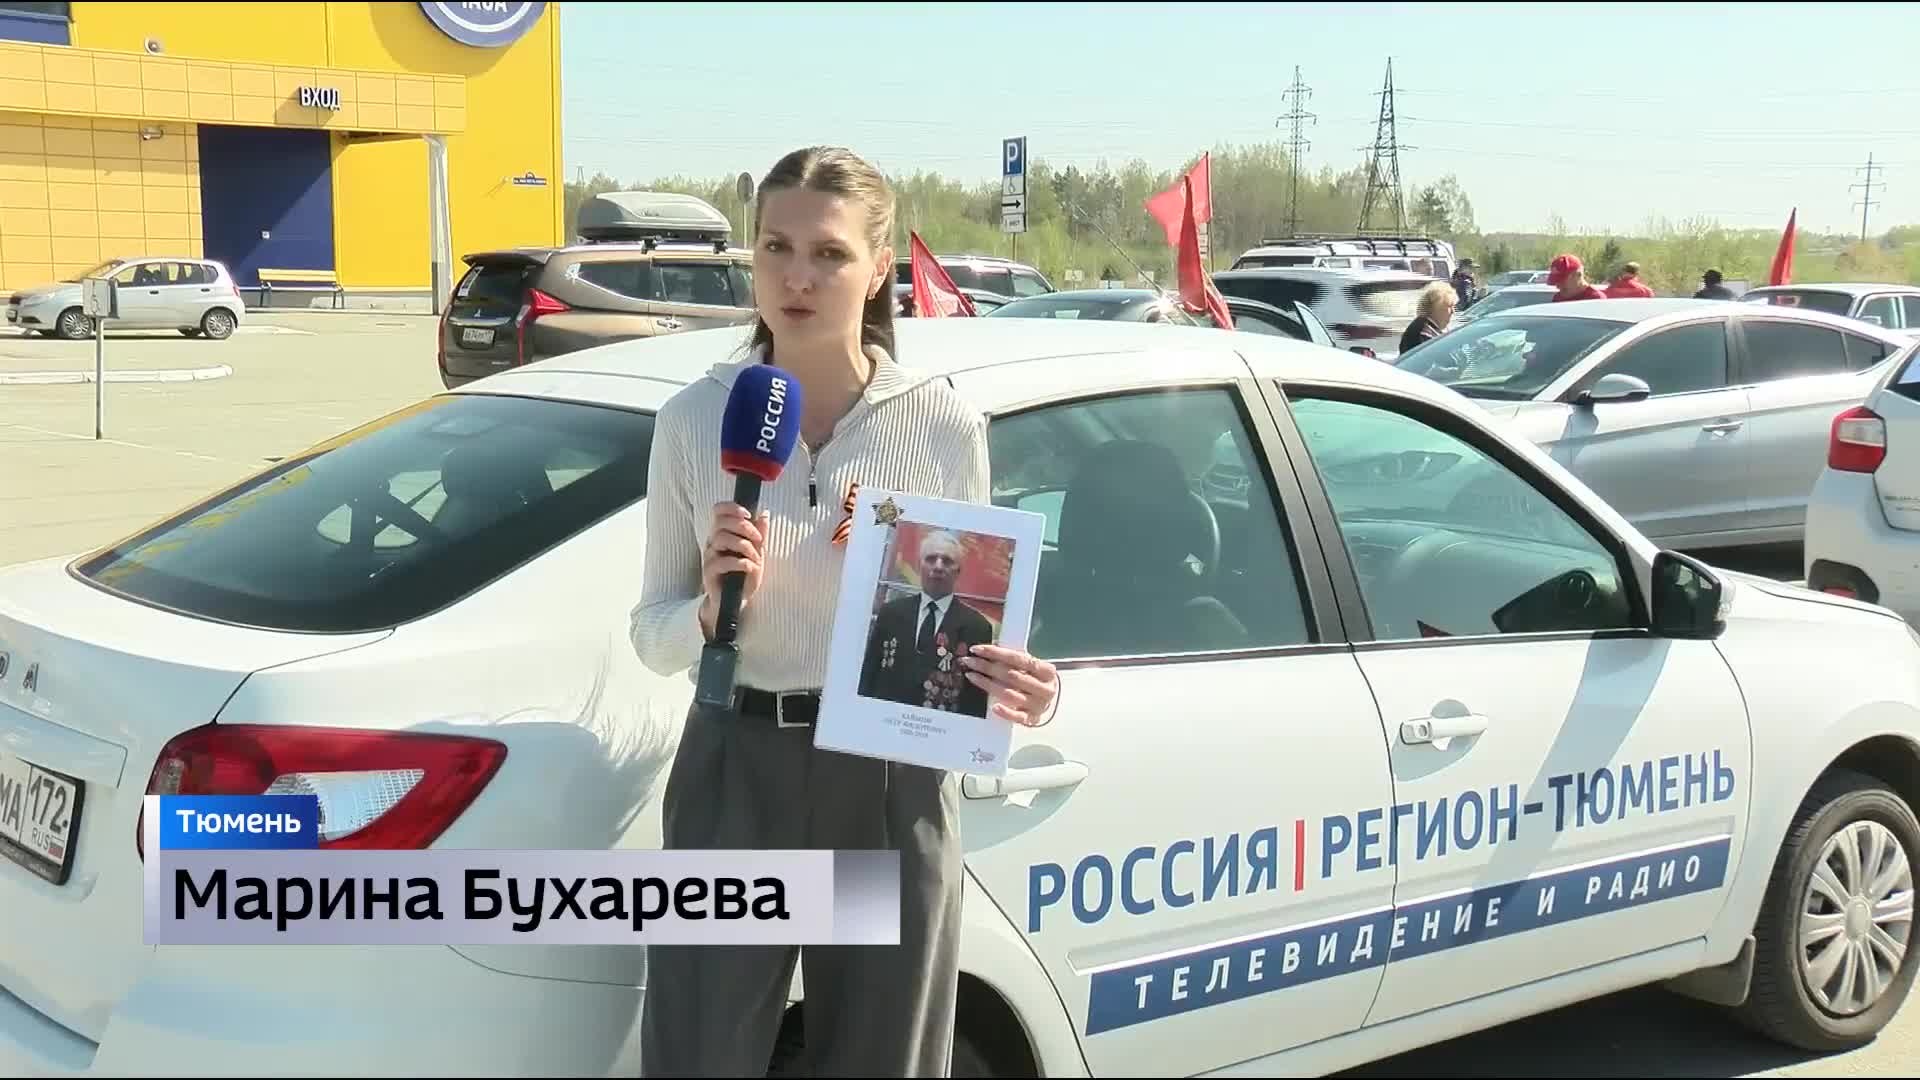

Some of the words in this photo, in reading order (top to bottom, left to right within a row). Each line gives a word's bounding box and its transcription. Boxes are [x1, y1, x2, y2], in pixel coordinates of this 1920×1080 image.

[300, 87, 341, 110] ВХОД
[756, 377, 788, 453] РОССИЯ
[30, 774, 67, 835] 172
[31, 827, 49, 850] RUS
[1027, 826, 1279, 934] РОССИЯ
[1320, 749, 1736, 880] РЕГИОН-ТЮМЕНЬ
[1134, 896, 1502, 1011] ТЕЛЕВИДЕНИЕ
[1537, 885, 1558, 917] И
[1584, 855, 1701, 906] РАДИО
